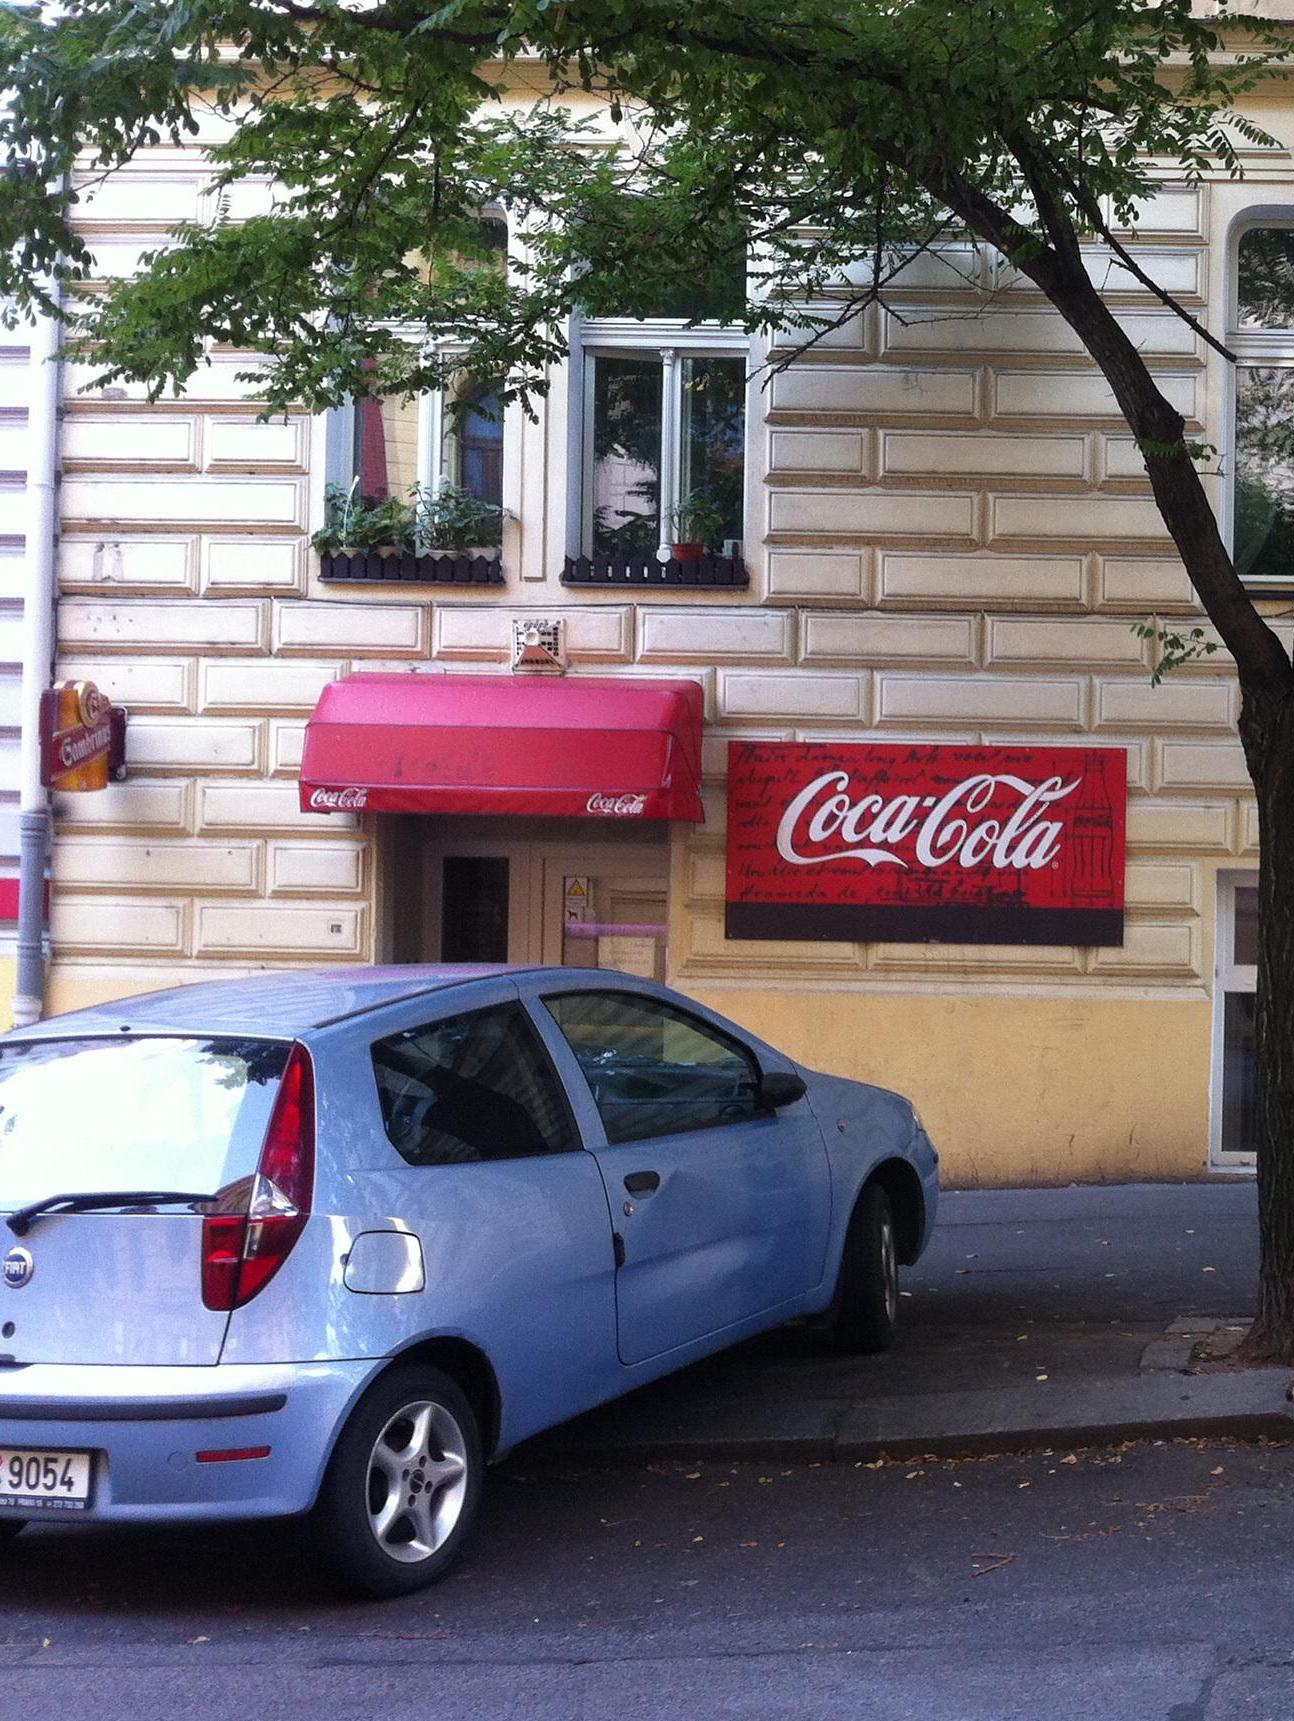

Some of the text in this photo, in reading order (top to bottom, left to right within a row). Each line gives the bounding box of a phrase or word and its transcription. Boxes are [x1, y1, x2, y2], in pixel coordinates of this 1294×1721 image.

[776, 770, 1083, 870] Coca-Cola
[4, 1261, 26, 1275] FIAT
[8, 1455, 75, 1493] 9054
